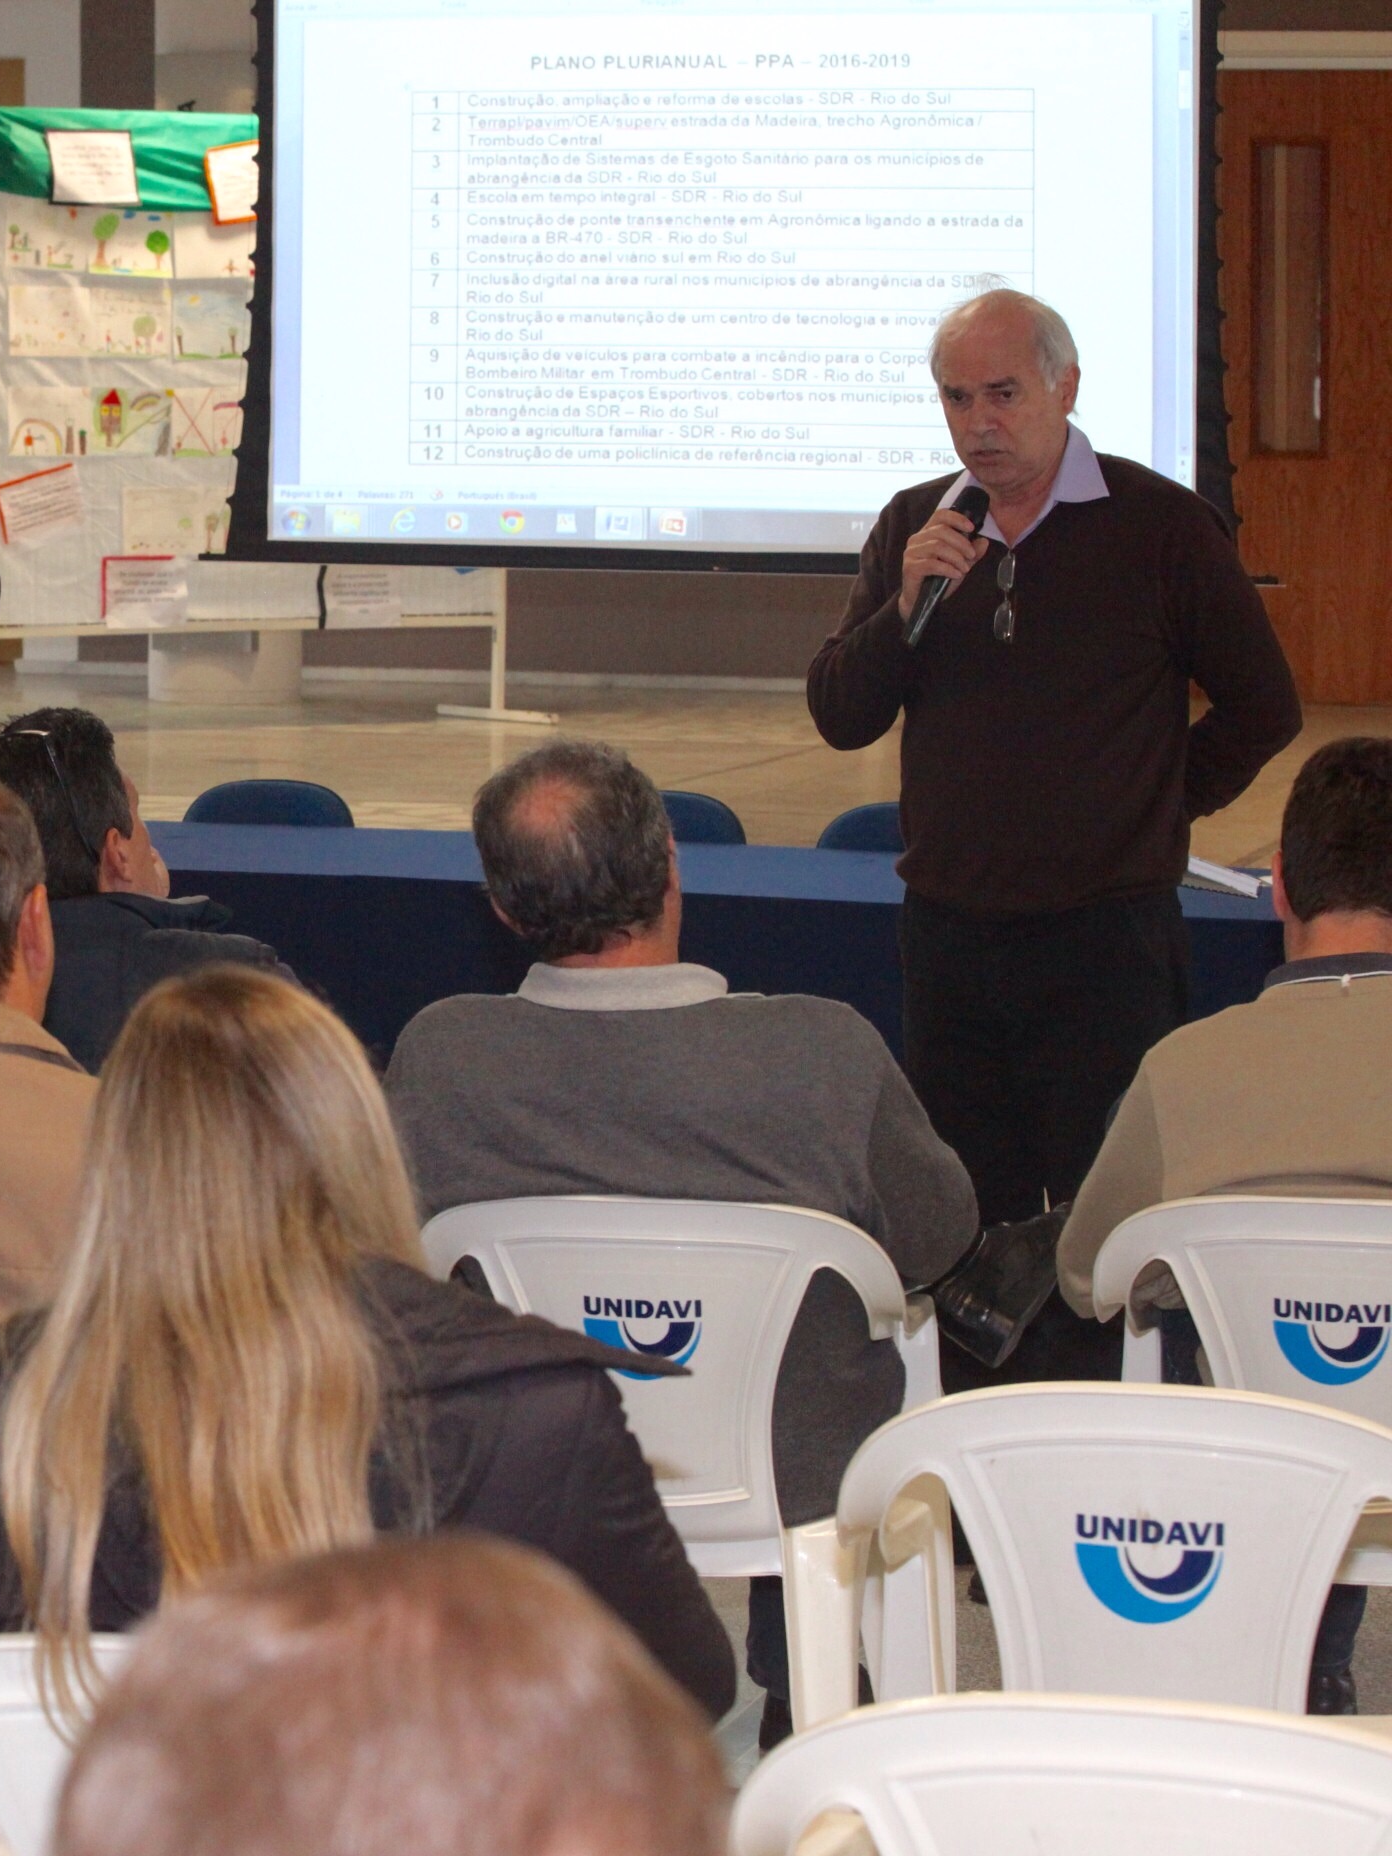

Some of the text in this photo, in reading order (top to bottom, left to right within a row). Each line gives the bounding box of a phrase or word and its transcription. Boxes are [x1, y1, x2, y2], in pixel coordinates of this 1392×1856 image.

[531, 53, 911, 70] PLANO PLURIANUAL PPA 2016-2019
[432, 96, 439, 109] 1
[562, 93, 640, 108] ampliação
[657, 93, 715, 105] reforma
[721, 94, 740, 105] de
[745, 93, 804, 105] escolas
[818, 92, 854, 104] SDR
[870, 92, 896, 104] Rio
[926, 92, 951, 104] Sul
[431, 117, 441, 132] 2
[671, 115, 727, 127] estrada
[731, 115, 750, 126] da
[827, 115, 875, 126] trecho
[880, 114, 975, 130] Agronômica
[468, 134, 602, 146] Trombudo Central
[431, 152, 984, 168] 3 Implantação de Sistemas de Esgoto Sanitário para os municípios de
[468, 171, 717, 186] abrangência da SDR Rio Sul
[430, 190, 803, 206] 4 Escola em tempo integral SDR Rio Sul
[432, 214, 440, 228] 5
[467, 213, 554, 228] Construção
[557, 213, 575, 226] de
[580, 215, 622, 228] ponte
[740, 216, 763, 226] em
[768, 214, 861, 229] Agronômica
[866, 214, 922, 229] ligando
[941, 215, 1000, 227] estrada
[1004, 215, 1024, 227] da
[467, 231, 748, 244] madeira BR-470 SDR Rio Sul
[431, 251, 796, 266] 6 Construção anel viário sul em Rio Sul
[431, 273, 946, 290] 7 Inclusão digital na área rural nos municípios de abrangência da
[466, 291, 543, 303] Rio Sul
[430, 310, 876, 328] 8 Construção manutenção de um centro de tecnologia
[466, 328, 543, 341] Rio Sul
[430, 348, 928, 367] 9 Aquisição de veículos para combate incêndio para Corpo
[465, 366, 905, 383] Bombeiro Militar em Trombudo Central SDR Rio Sul
[424, 386, 444, 400] 10
[465, 385, 552, 401] Construção
[555, 387, 574, 399] de
[578, 386, 644, 402] Espaços
[737, 389, 804, 401] cobertos
[808, 392, 836, 402] nos
[841, 391, 925, 405] municípios
[465, 404, 719, 419] abrangência da SDR Rio Sul
[424, 424, 810, 440] 11 Apoio agricultura familiar SDR Rio Sul
[423, 445, 956, 466] 12 Construção de uma policlínica de referência regional SDR Rio
[583, 1295, 702, 1318] UNIDAVI
[1273, 1298, 1391, 1323] UNIDAVI
[1076, 1513, 1224, 1546] UNIDAVI
